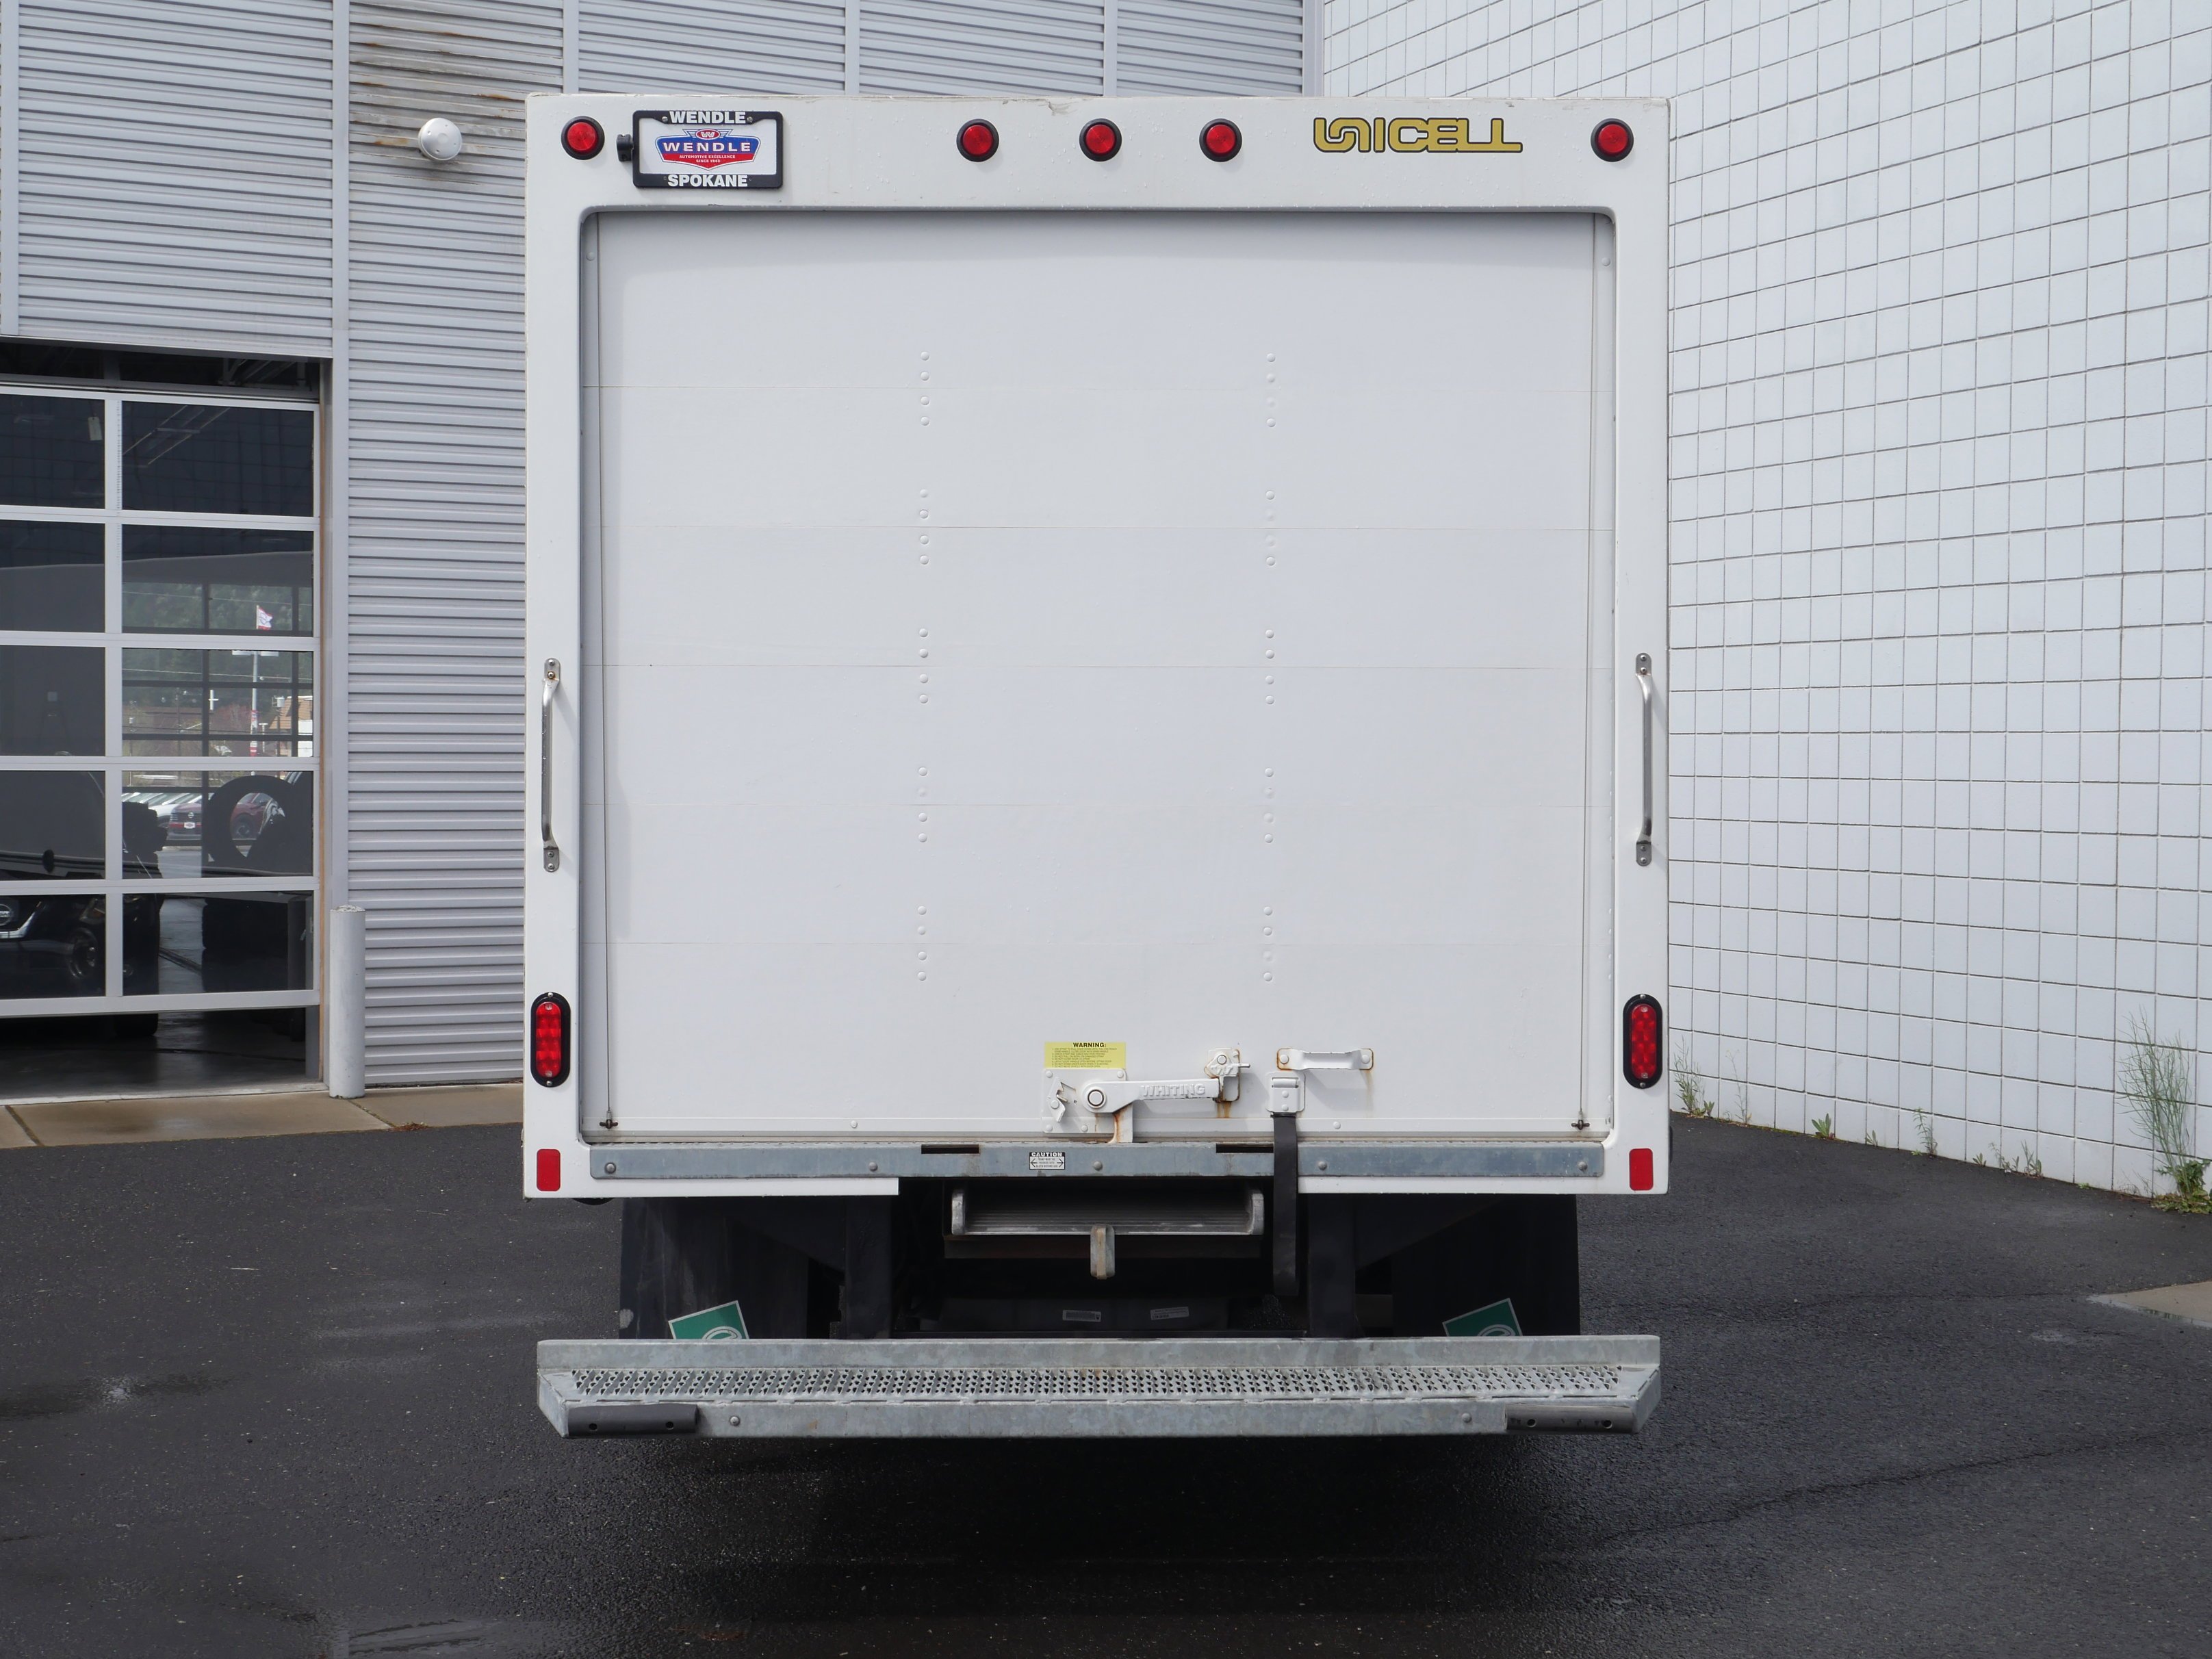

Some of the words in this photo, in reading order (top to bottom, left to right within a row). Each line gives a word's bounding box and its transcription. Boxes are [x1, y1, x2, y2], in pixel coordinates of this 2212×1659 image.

[669, 111, 746, 124] WENDLE
[663, 142, 751, 152] WENDLE
[667, 175, 748, 187] SPOKANE
[1140, 1083, 1205, 1097] WHITING
